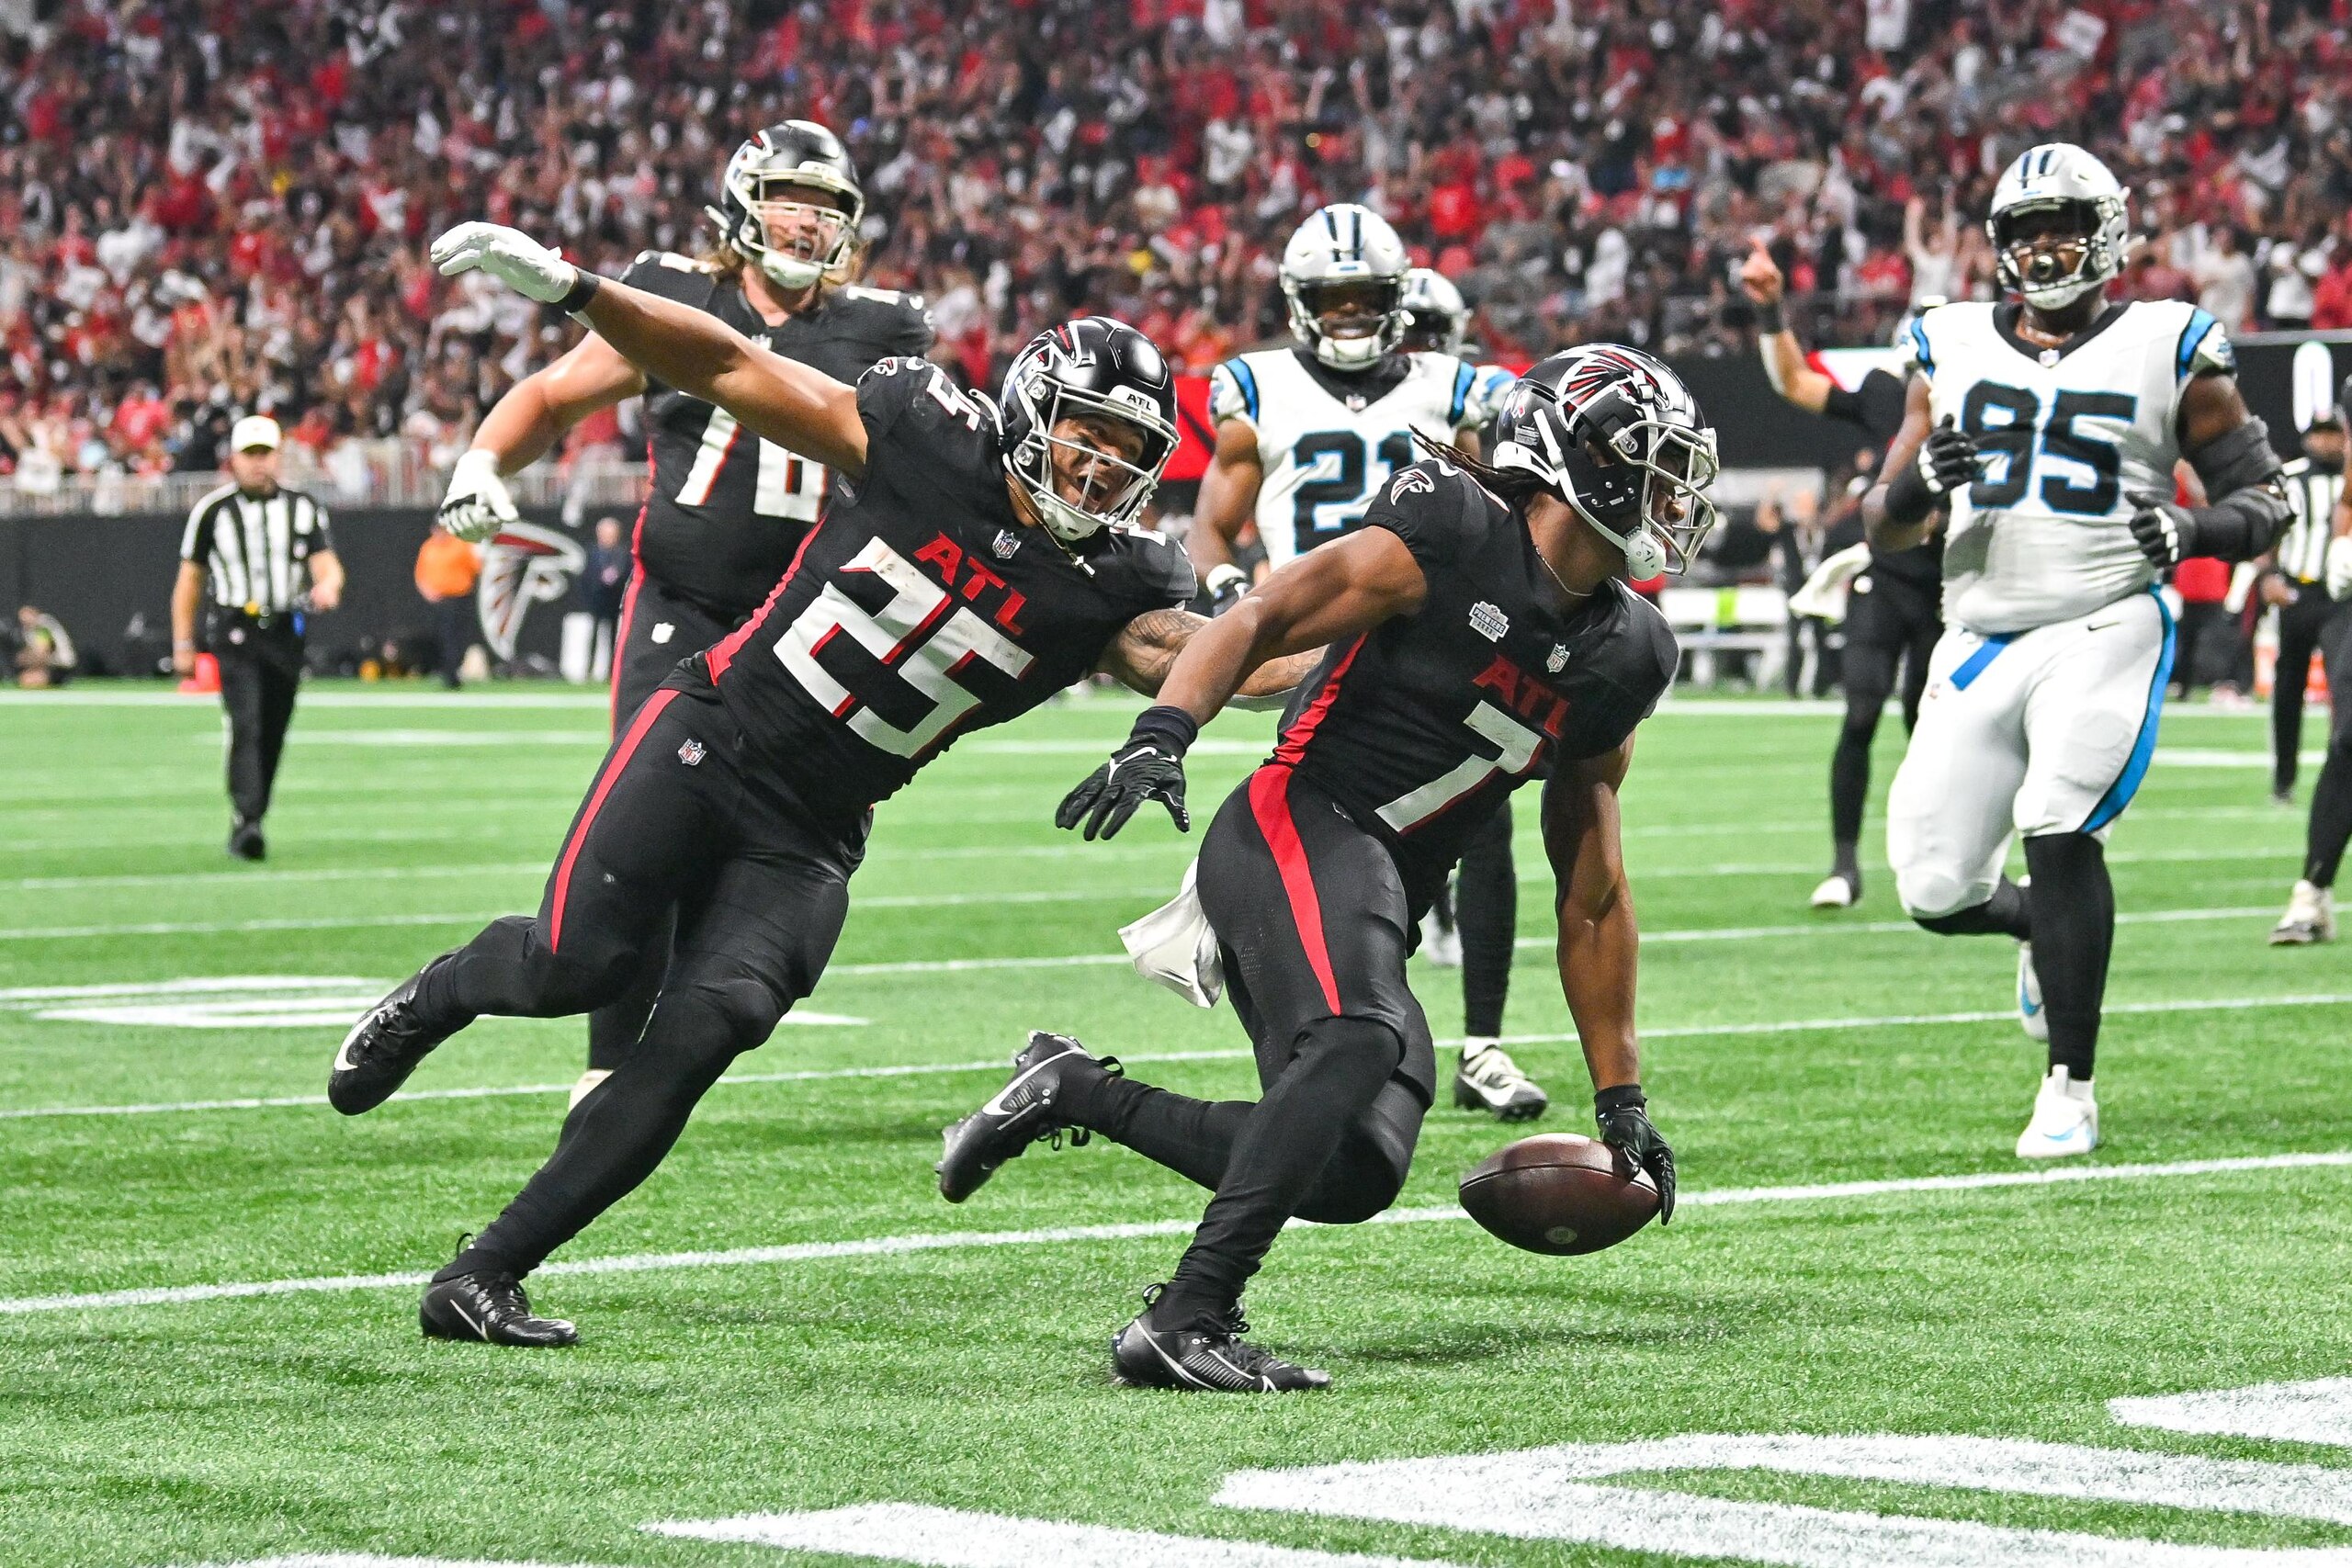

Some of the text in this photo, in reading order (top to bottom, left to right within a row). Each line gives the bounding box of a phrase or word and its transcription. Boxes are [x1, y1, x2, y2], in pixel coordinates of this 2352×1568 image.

[1126, 393, 1152, 411] ATL
[1961, 378, 2139, 516] 95
[912, 530, 1028, 636] ATL
[772, 535, 1037, 760] 25
[1472, 652, 1570, 739] ATL
[1374, 699, 1548, 837] 7
